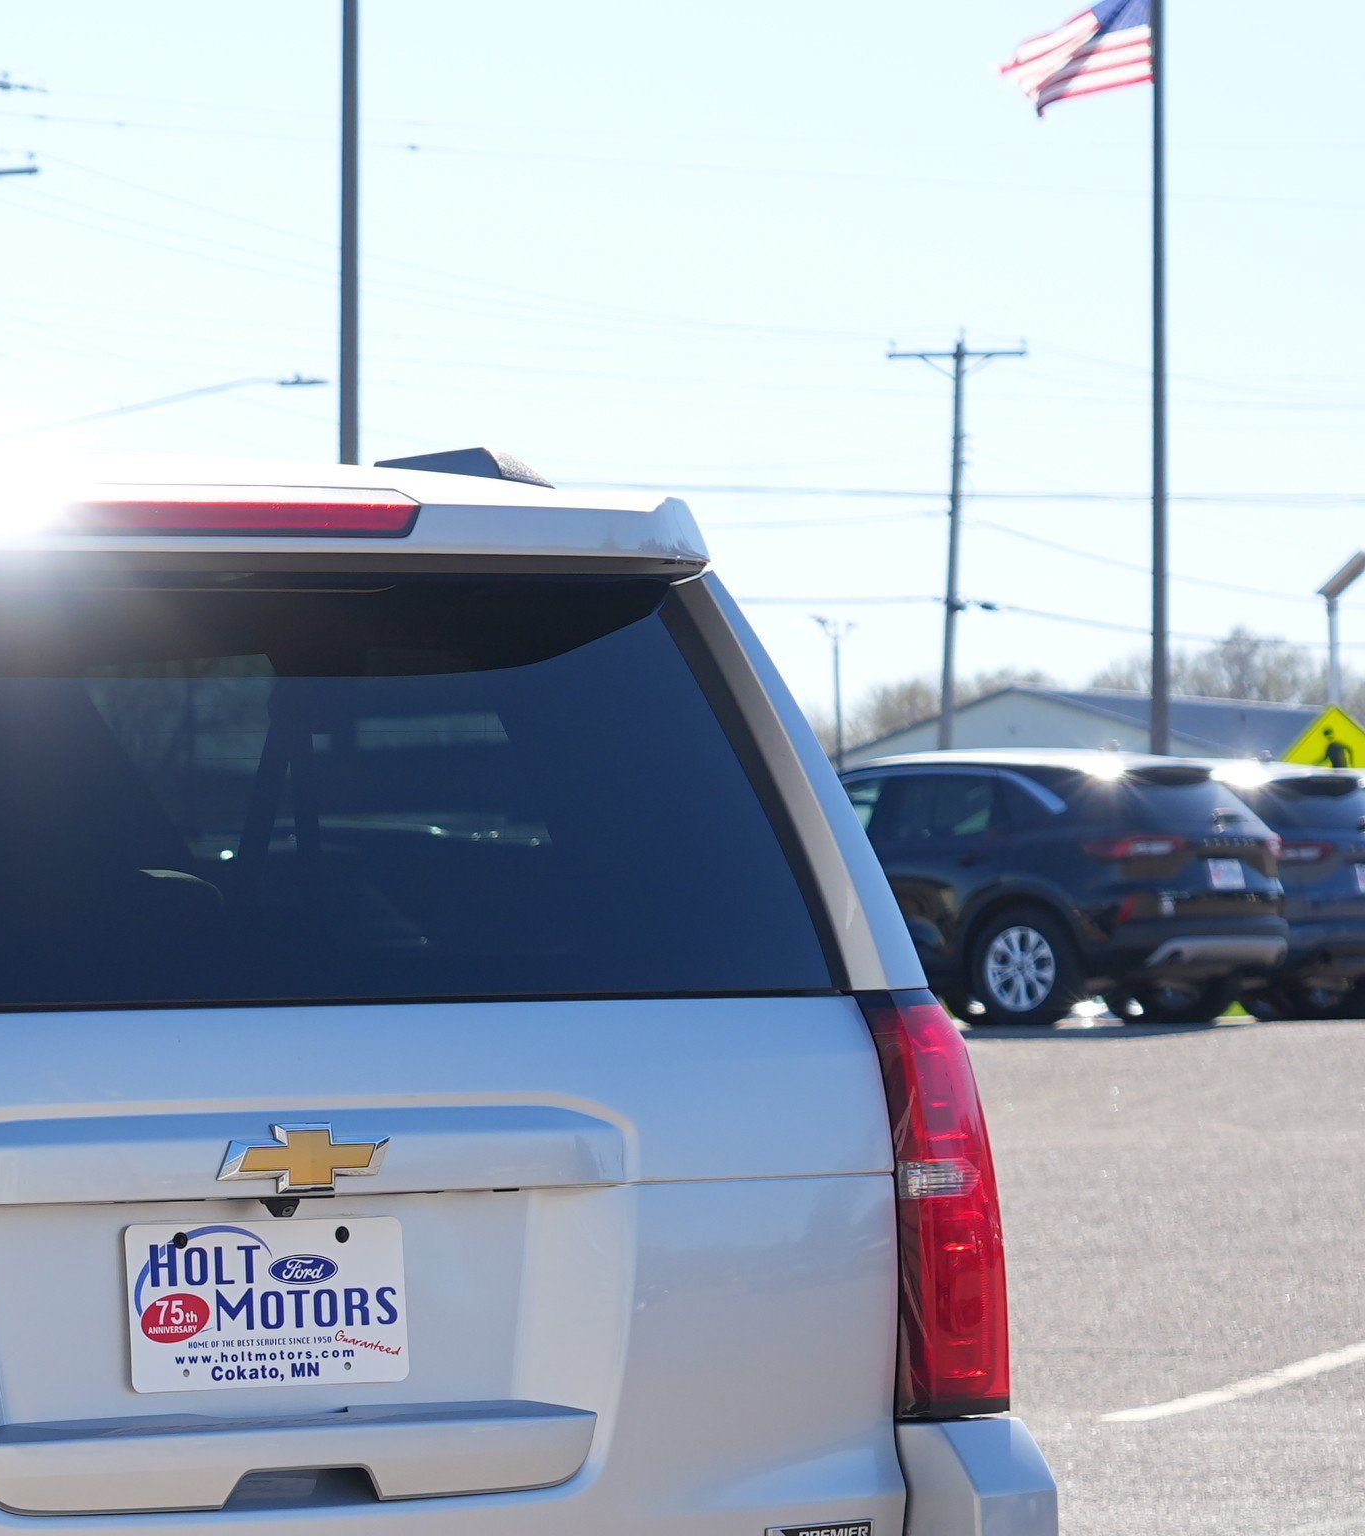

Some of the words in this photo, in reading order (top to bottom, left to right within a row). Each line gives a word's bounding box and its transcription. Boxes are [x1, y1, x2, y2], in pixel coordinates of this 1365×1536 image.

[149, 1243, 261, 1288] HOLT
[282, 1258, 324, 1280] Ford
[155, 1299, 198, 1326] 75th
[215, 1286, 398, 1332] MOTORS
[147, 1324, 198, 1335] ANNIVERSARY
[188, 1340, 209, 1349] HOME
[210, 1340, 220, 1348] OF
[222, 1339, 235, 1348] THE
[237, 1338, 254, 1347] BEST
[289, 1336, 311, 1345] SINCE
[313, 1335, 332, 1344] 1950
[334, 1330, 401, 1356] Guaranteed
[175, 1348, 355, 1365] www.holtmotors.com
[211, 1365, 285, 1382] Cokato,
[291, 1361, 320, 1378] MN
